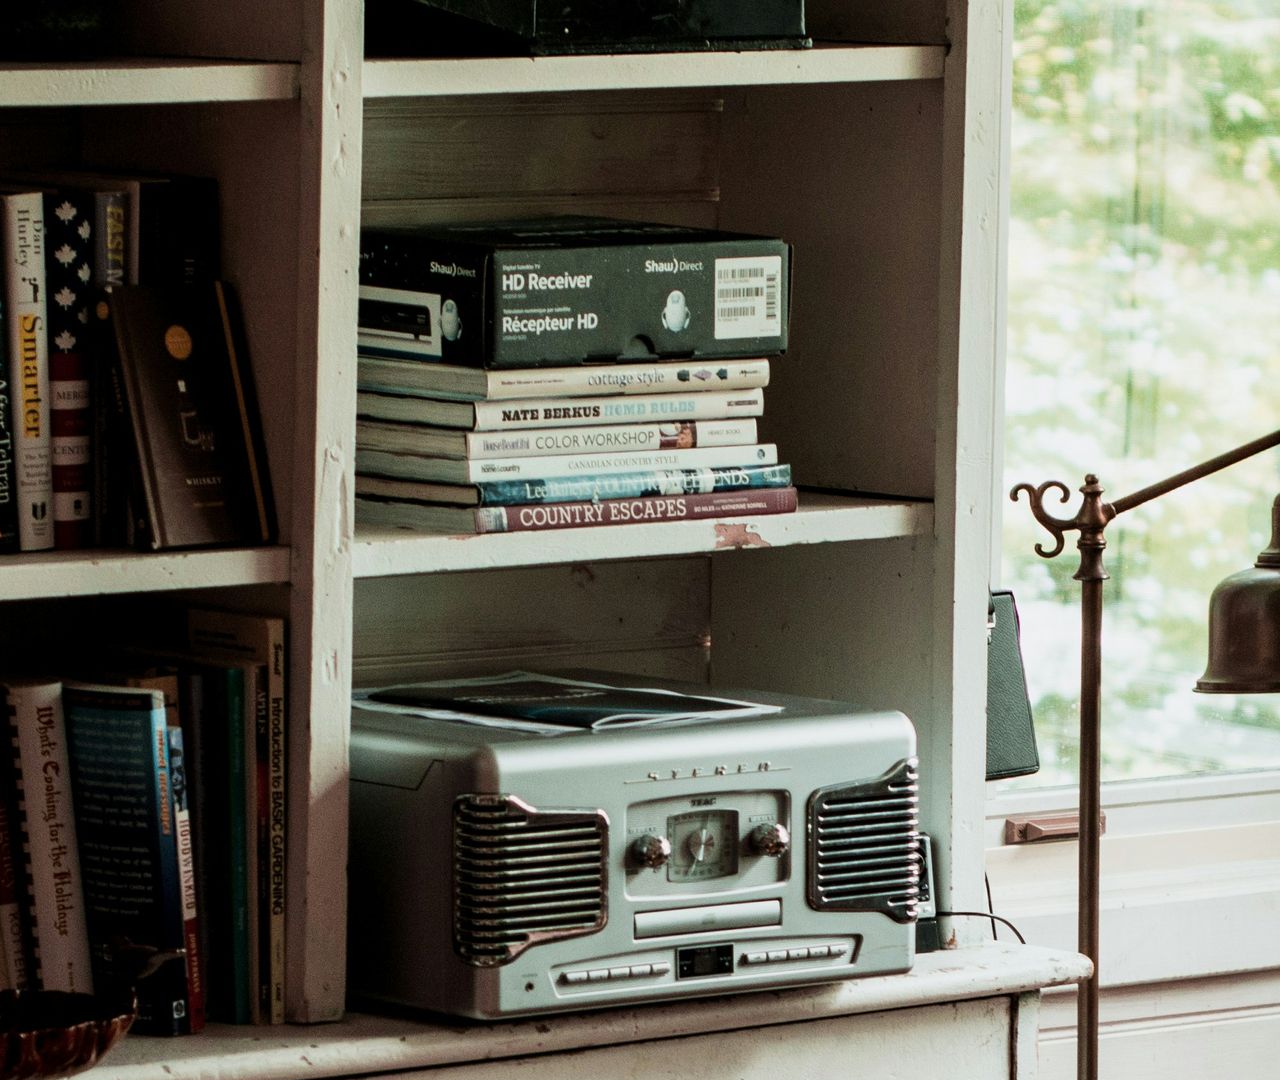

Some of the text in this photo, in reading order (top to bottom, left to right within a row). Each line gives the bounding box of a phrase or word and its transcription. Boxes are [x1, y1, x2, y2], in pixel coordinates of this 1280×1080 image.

[15, 209, 30, 267] Hurley
[33, 219, 42, 255] Dan
[457, 266, 476, 277] Direct
[680, 260, 704, 272] Direct
[502, 272, 593, 291] HD Receiver
[502, 312, 599, 335] Récepteur HD
[22, 315, 43, 438] Smarter
[588, 368, 665, 387] cottage style
[502, 401, 696, 422] NATE BERKUS HOME RULES
[536, 431, 655, 450] COLOR WORKSHOP
[568, 455, 679, 470] CANADIAN COUNTRY STYLE
[520, 498, 687, 527] COUNTRY ESCAPES
[271, 698, 283, 773] Introduction
[271, 775, 282, 789] to
[35, 706, 72, 937] What's Cooking for the Holidays
[271, 791, 283, 831] BASIC
[178, 819, 195, 910] HOODWINKED
[271, 835, 284, 916] GARDENING
